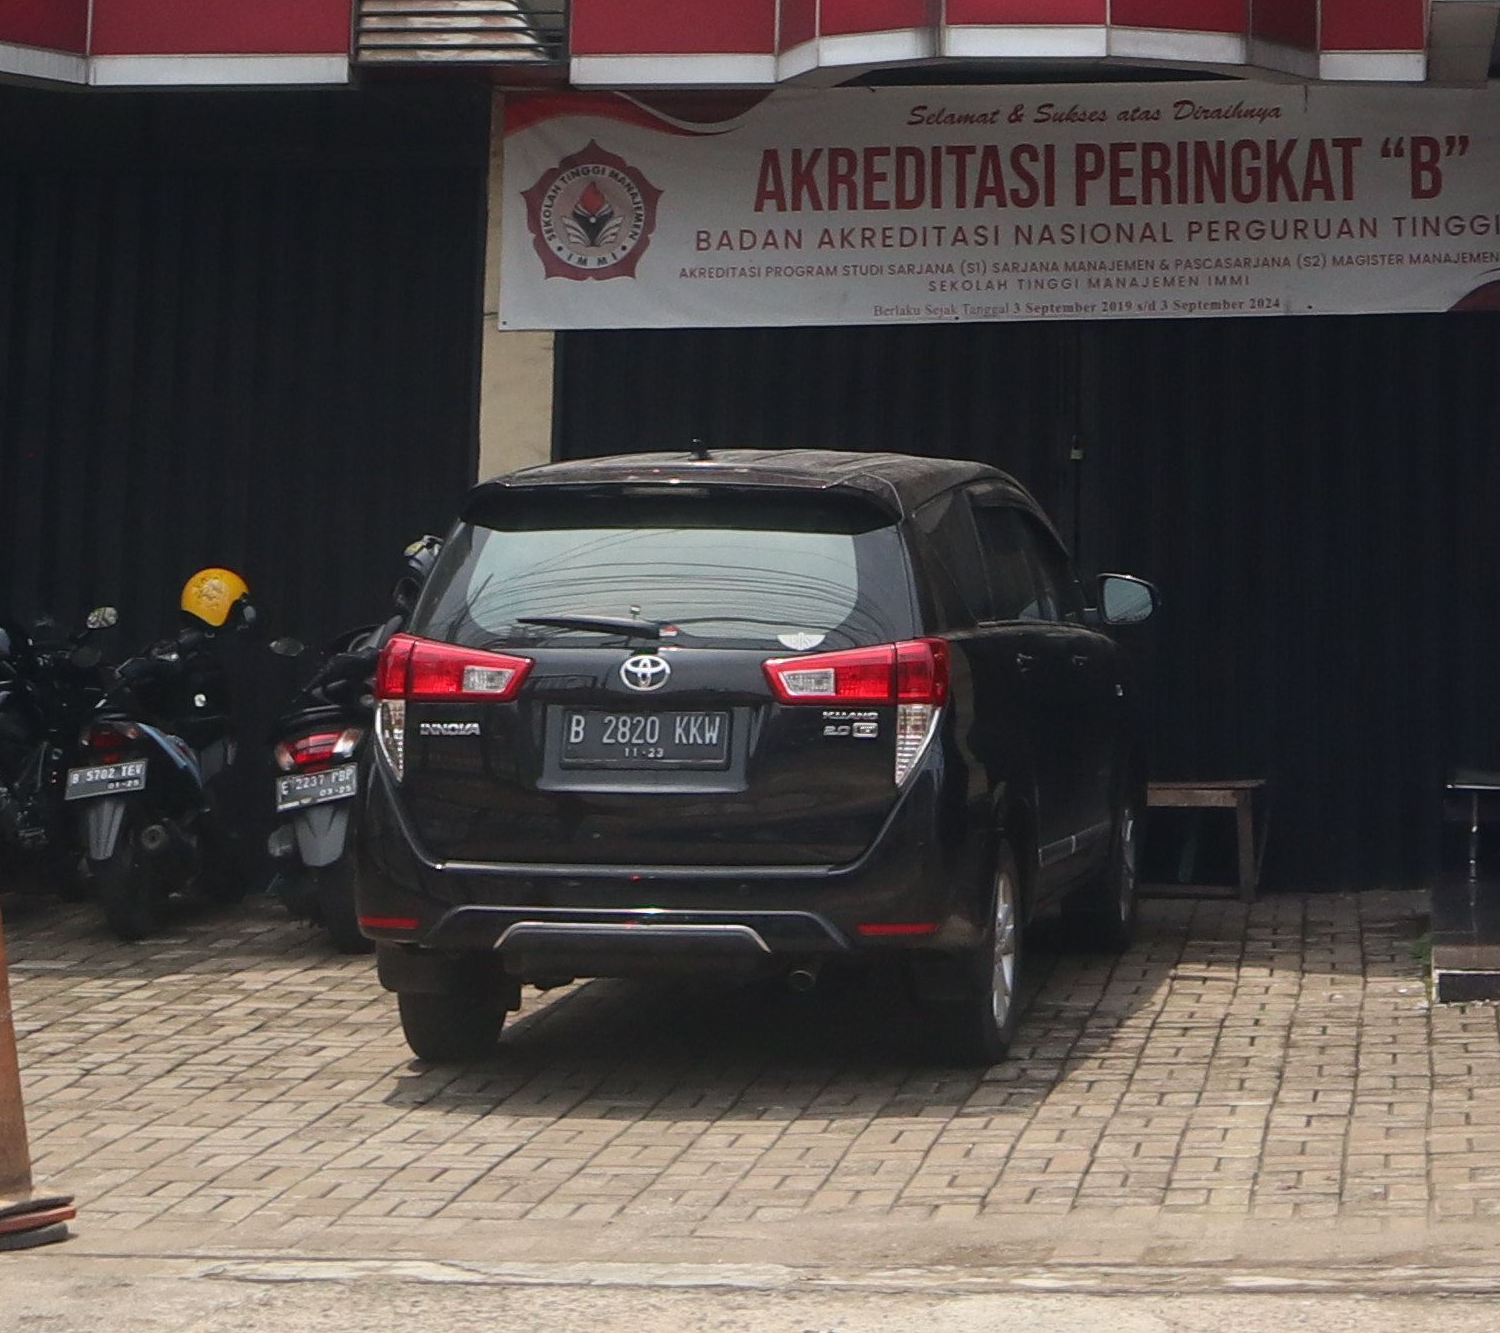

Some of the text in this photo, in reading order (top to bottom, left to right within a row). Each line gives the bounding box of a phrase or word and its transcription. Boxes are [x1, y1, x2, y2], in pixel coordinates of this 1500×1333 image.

[906, 99, 1283, 126] Selamat & Sukses atas Diraihnya
[753, 143, 1056, 213] AKREDITASI
[1074, 136, 1363, 208] PERINGKAT
[542, 165, 645, 242] SEKOLAH TINGGI MANAJEMEN
[695, 213, 1500, 252] BADAN AKREDITASI NASIONAL PERGURUAN TINGGI
[679, 250, 1500, 279] AKREDITASI PROGRAM STUDI SARJANA (S1) SARJANA MANAJEMEN & PASCASARJANA (S2) MAGISTER MANAJEMEN
[928, 273, 1251, 293] SEKOLAH TINGGI MANAJEMEN IMMI
[873, 297, 1281, 319] Berlaku Sejak Tanggal 3 September 2019 s/d 3 September 2024
[419, 721, 482, 737] INNOVA
[569, 715, 721, 745] B 2820 KKW
[86, 767, 116, 782] 5702
[295, 774, 325, 791] 2237
